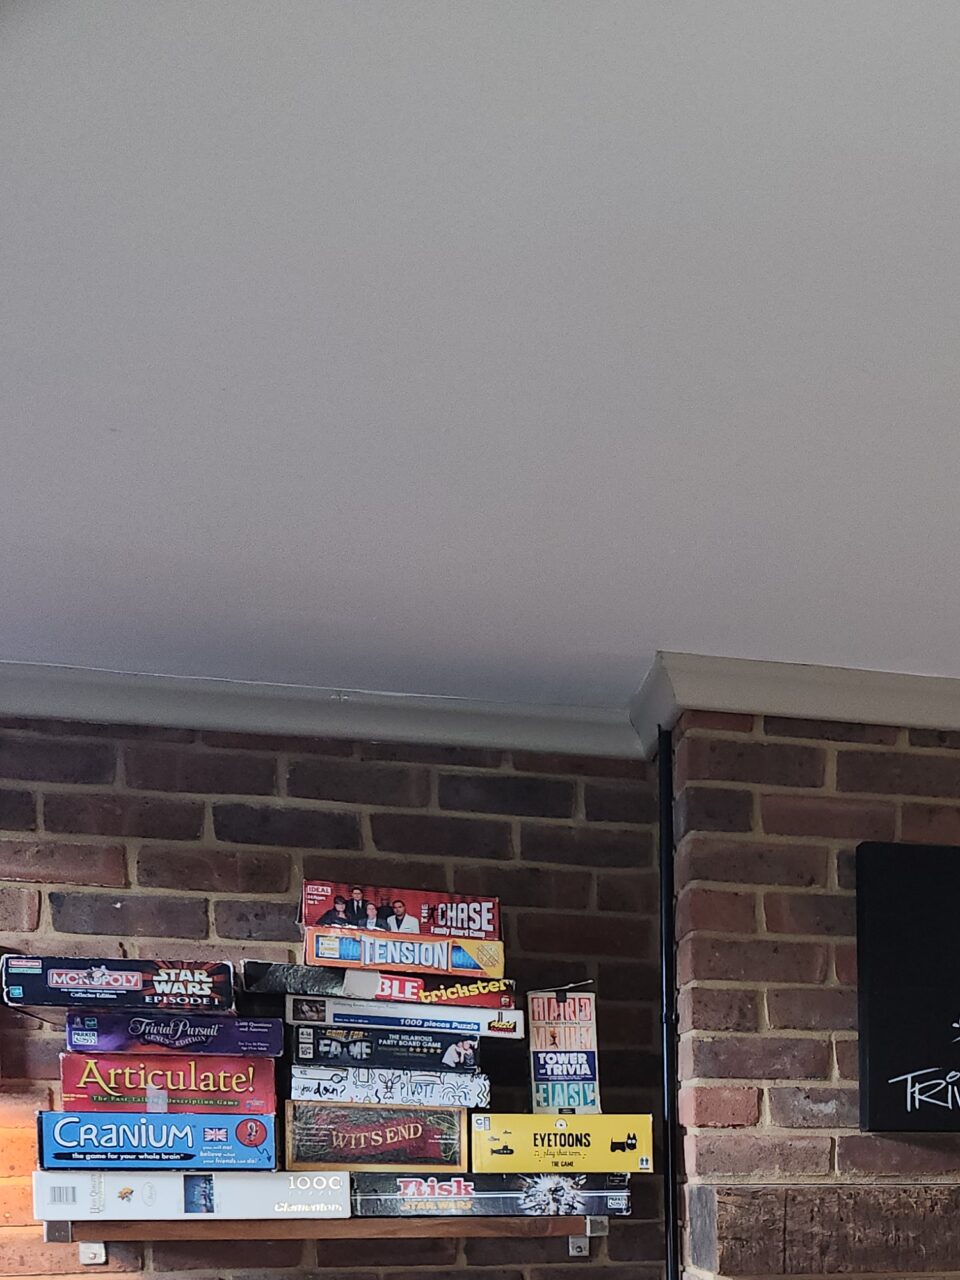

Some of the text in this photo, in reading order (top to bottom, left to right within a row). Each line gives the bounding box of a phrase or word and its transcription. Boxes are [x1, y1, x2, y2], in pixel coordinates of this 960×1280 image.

[308, 886, 330, 894] IDEAL
[421, 903, 429, 924] THE
[438, 901, 494, 932] CHASE
[361, 934, 450, 971] TENSION
[52, 972, 139, 987] MONOPOLY
[153, 968, 213, 982] STAR
[153, 981, 214, 996] WARS
[377, 979, 418, 999] BLE
[419, 979, 510, 1003] trickster
[145, 995, 211, 1005] EPISODE
[532, 997, 592, 1021] HARD
[128, 1017, 219, 1040] Trivial Pursuit
[399, 1018, 479, 1030] 1000 pieces Puzzle
[175, 1035, 206, 1047] EDITION
[349, 1031, 364, 1039] FOR
[378, 1038, 397, 1046] PARTY
[401, 1034, 433, 1042] HILARIOUS
[319, 1039, 372, 1059] FAME
[538, 1052, 588, 1065] TOWER
[76, 1059, 255, 1096] Articulate!
[400, 1082, 435, 1098] PIVOT!
[536, 1083, 596, 1106] EASY
[331, 1130, 383, 1149] WIT'S
[385, 1123, 423, 1144] END
[533, 1132, 592, 1148] EYETOONS
[288, 1175, 343, 1190] 1000
[396, 1177, 476, 1198] Risk
[400, 1200, 474, 1211] STAR WARS
